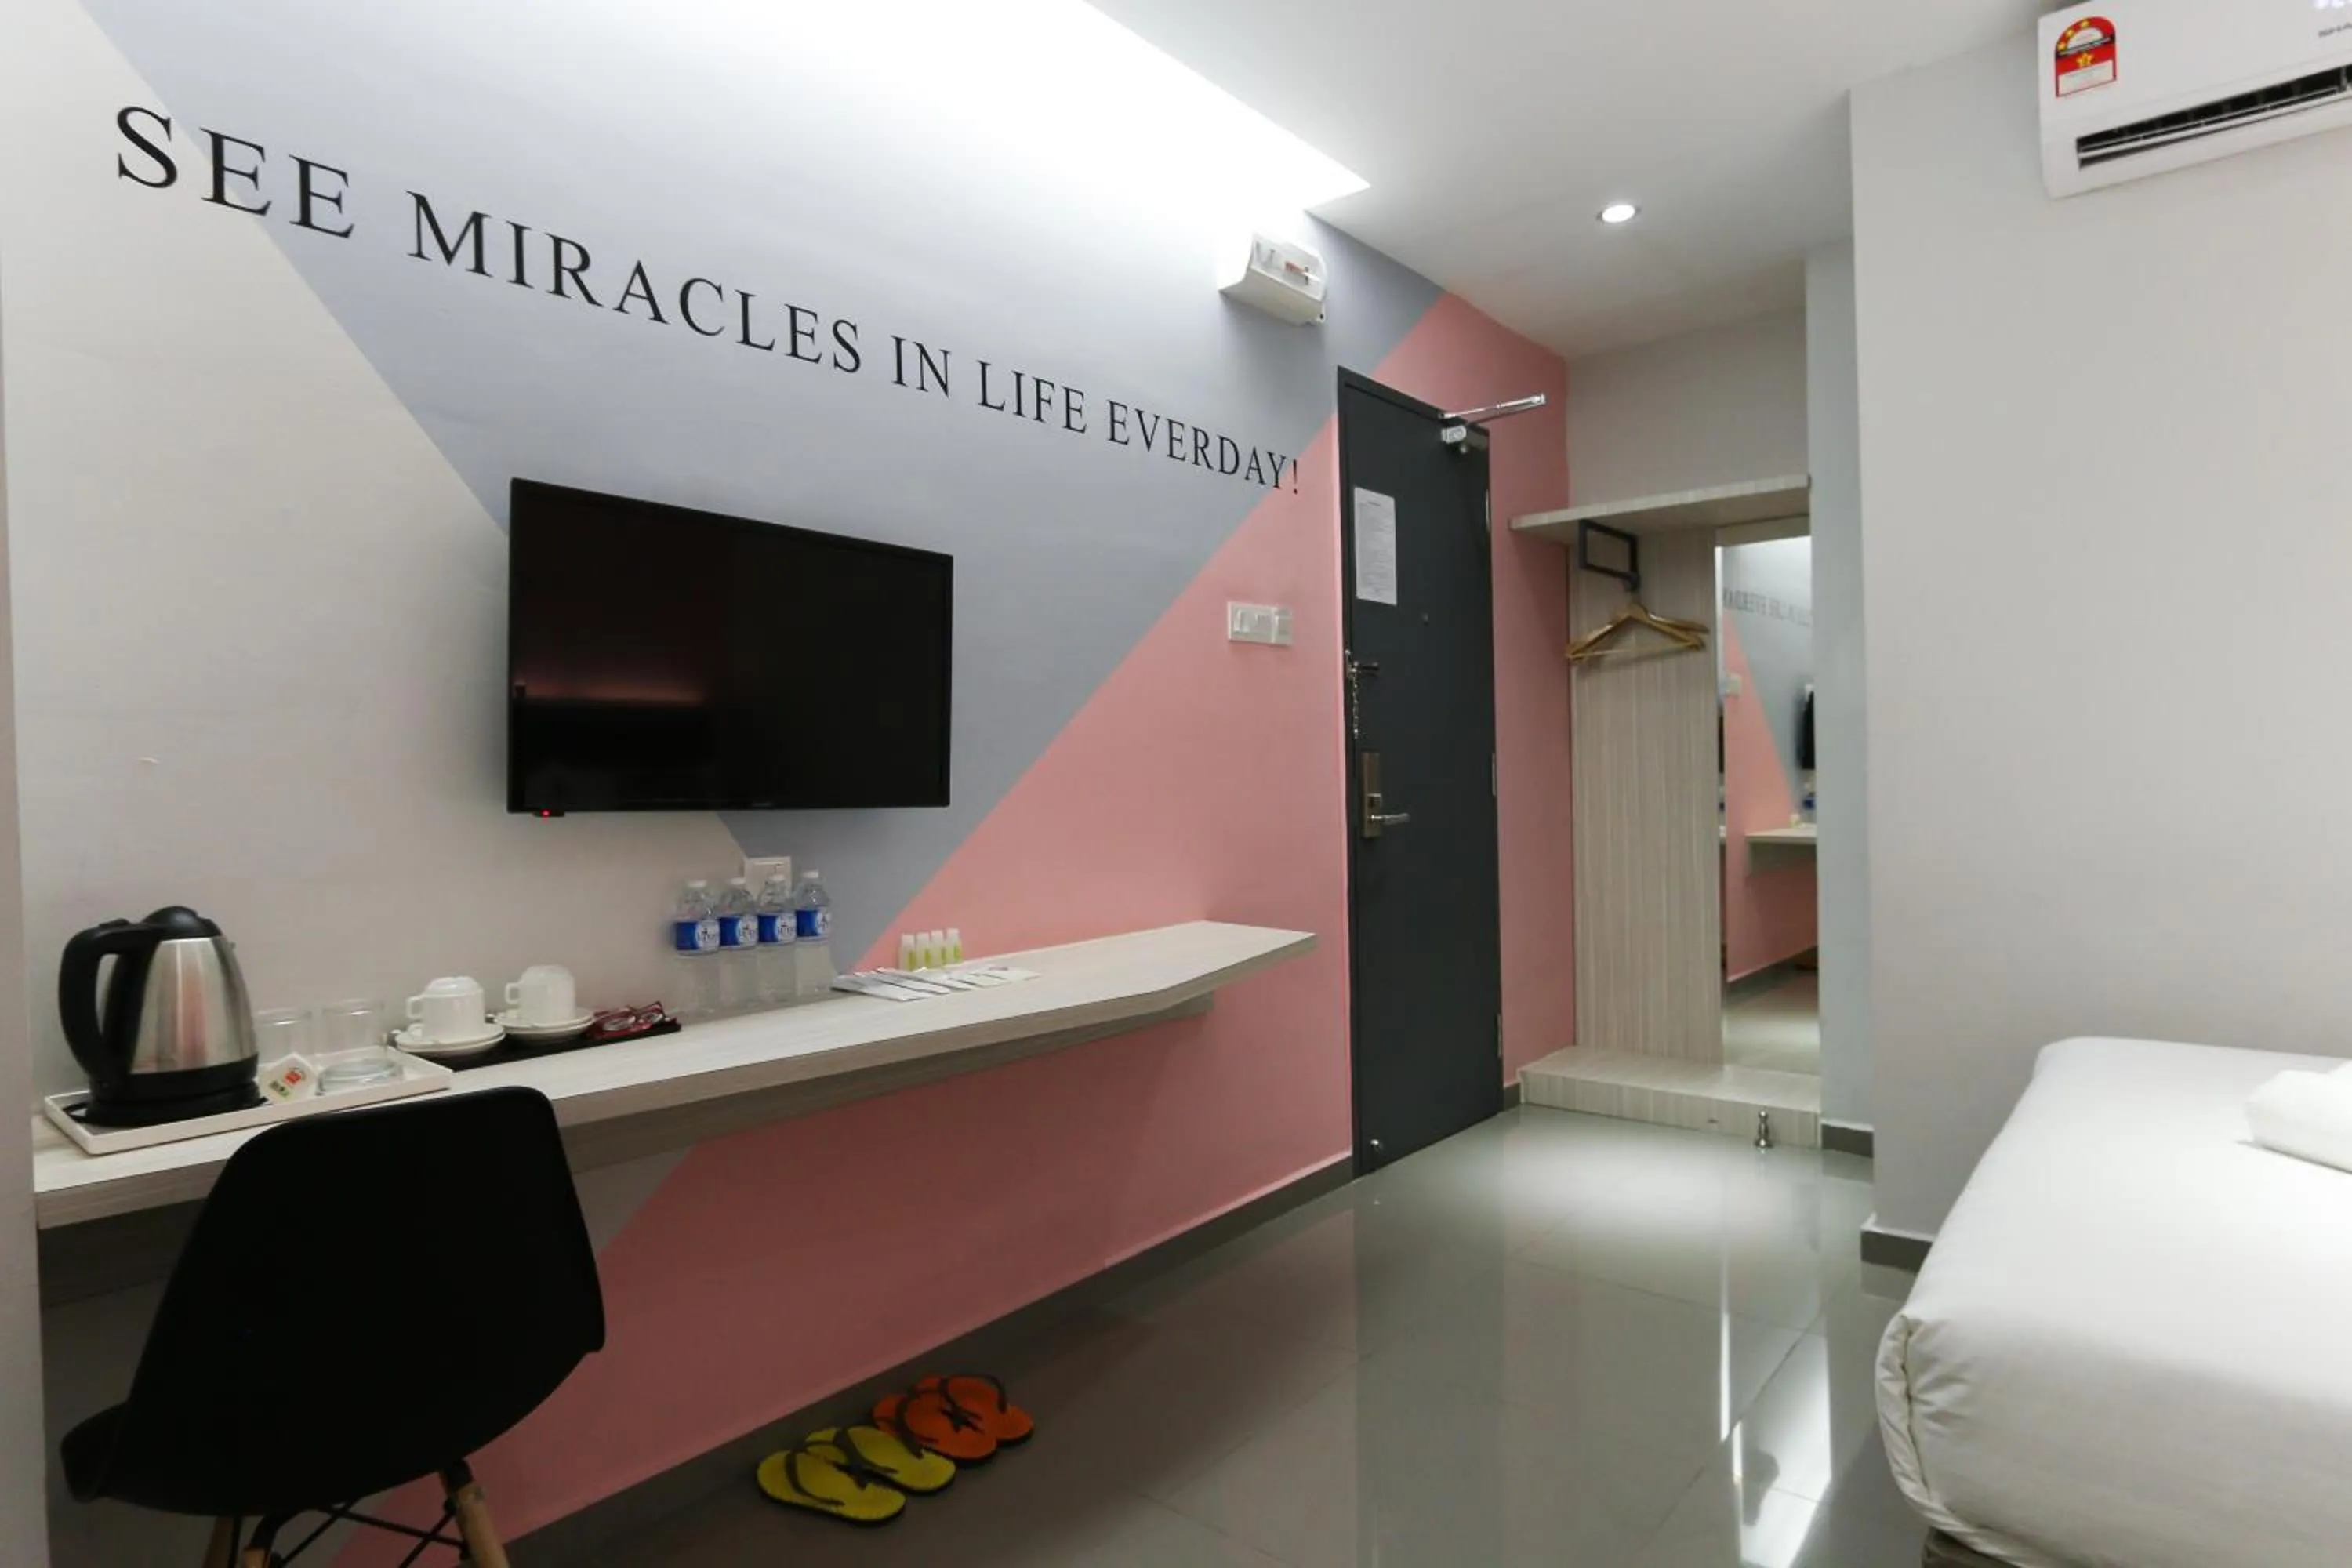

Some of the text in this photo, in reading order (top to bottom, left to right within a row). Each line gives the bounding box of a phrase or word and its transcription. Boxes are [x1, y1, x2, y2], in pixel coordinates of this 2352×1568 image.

[116, 106, 1300, 494] SEE MIRACLES IN LIFE EVERDAY!
